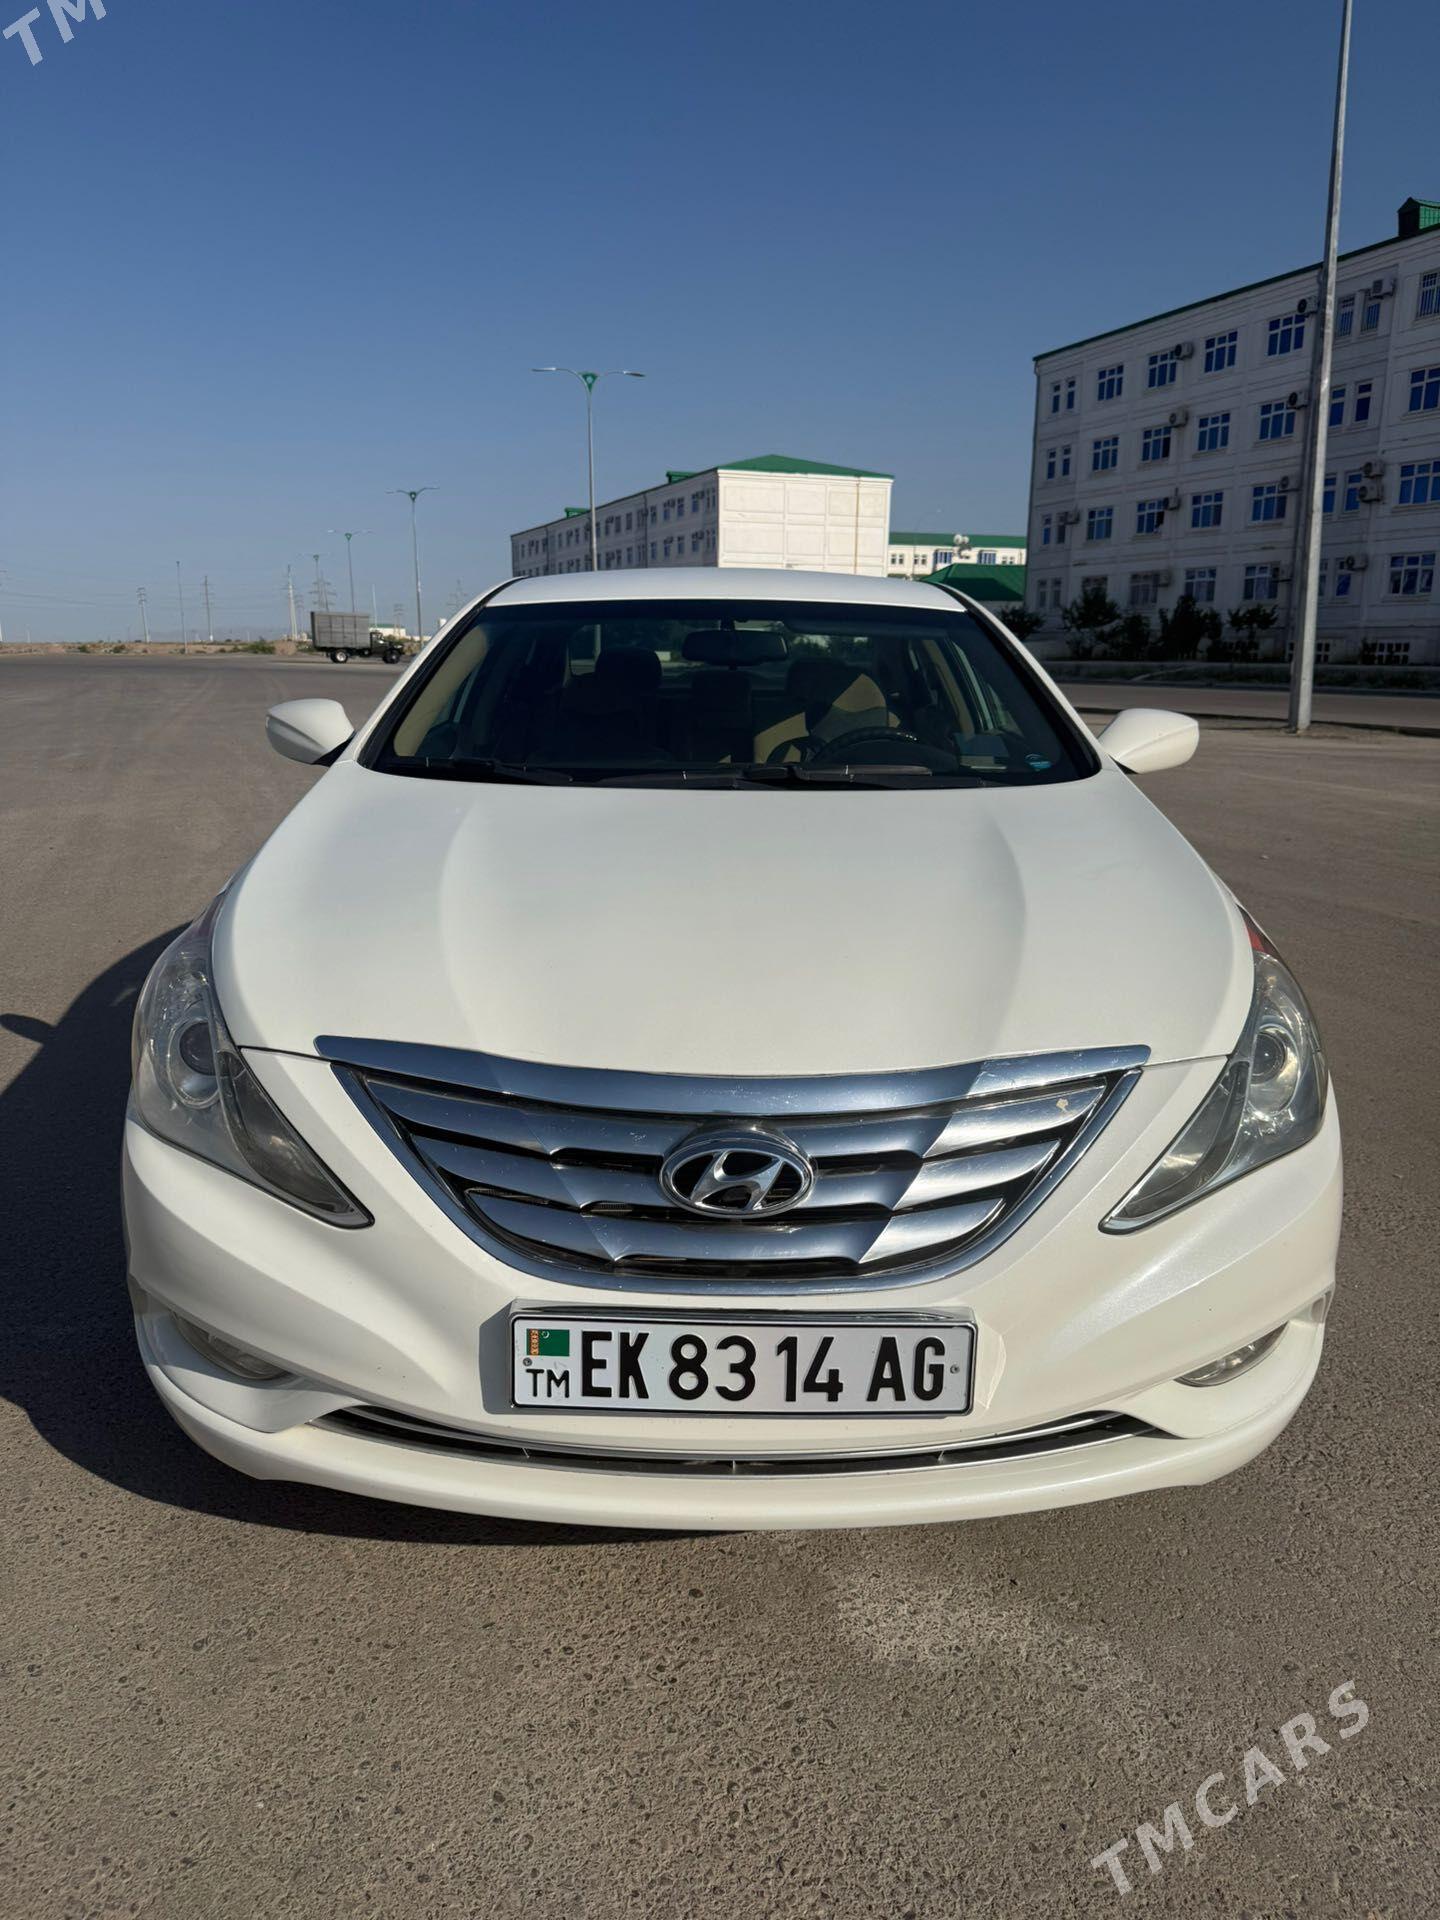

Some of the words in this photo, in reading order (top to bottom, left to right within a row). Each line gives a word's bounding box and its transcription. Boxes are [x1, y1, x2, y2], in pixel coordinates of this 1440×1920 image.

[526, 1368, 570, 1398] TM
[581, 1330, 650, 1399] EK
[866, 1336, 946, 1402] AG
